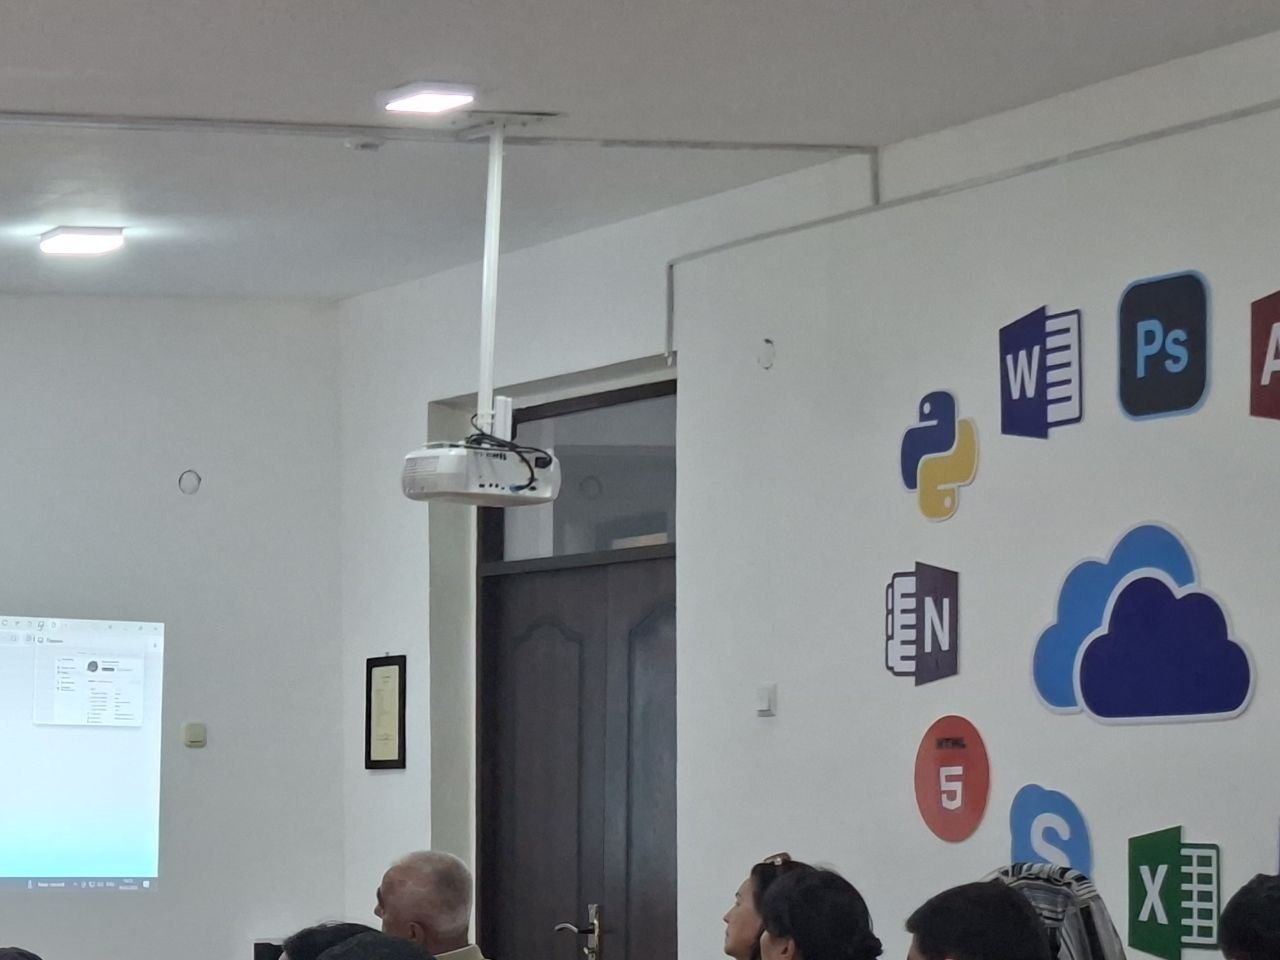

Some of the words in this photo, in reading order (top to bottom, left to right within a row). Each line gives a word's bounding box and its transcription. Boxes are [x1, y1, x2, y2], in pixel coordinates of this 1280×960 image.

[1005, 343, 1041, 401] W
[1135, 317, 1190, 379] Ps
[923, 595, 950, 653] N
[939, 765, 964, 811] 5
[1136, 863, 1169, 926] X
